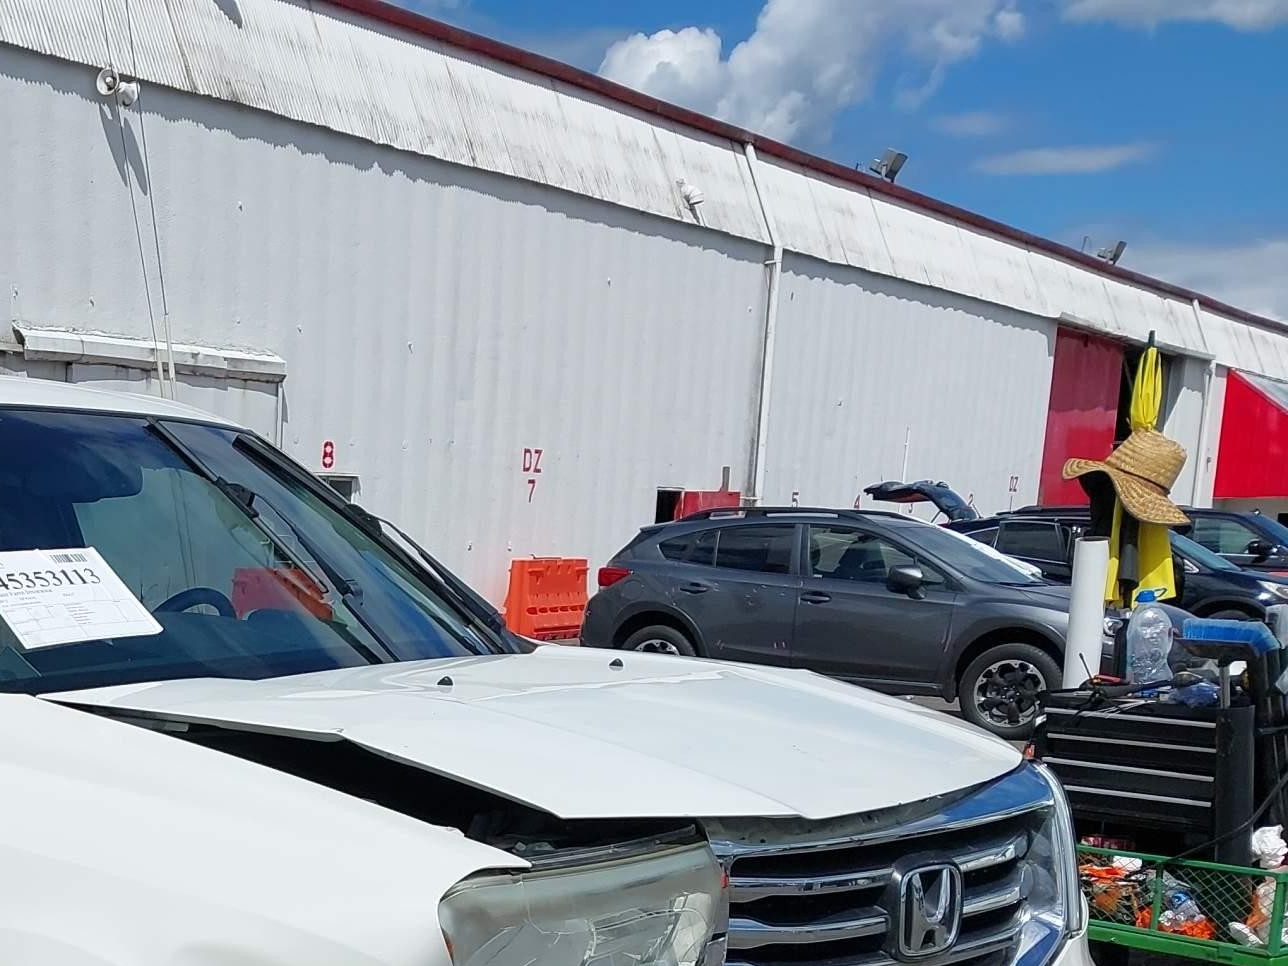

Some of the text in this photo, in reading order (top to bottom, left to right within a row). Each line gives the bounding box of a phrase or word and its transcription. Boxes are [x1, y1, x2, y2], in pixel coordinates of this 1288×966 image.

[322, 441, 334, 468] 8
[522, 448, 543, 473] DZ
[527, 479, 536, 503] 7
